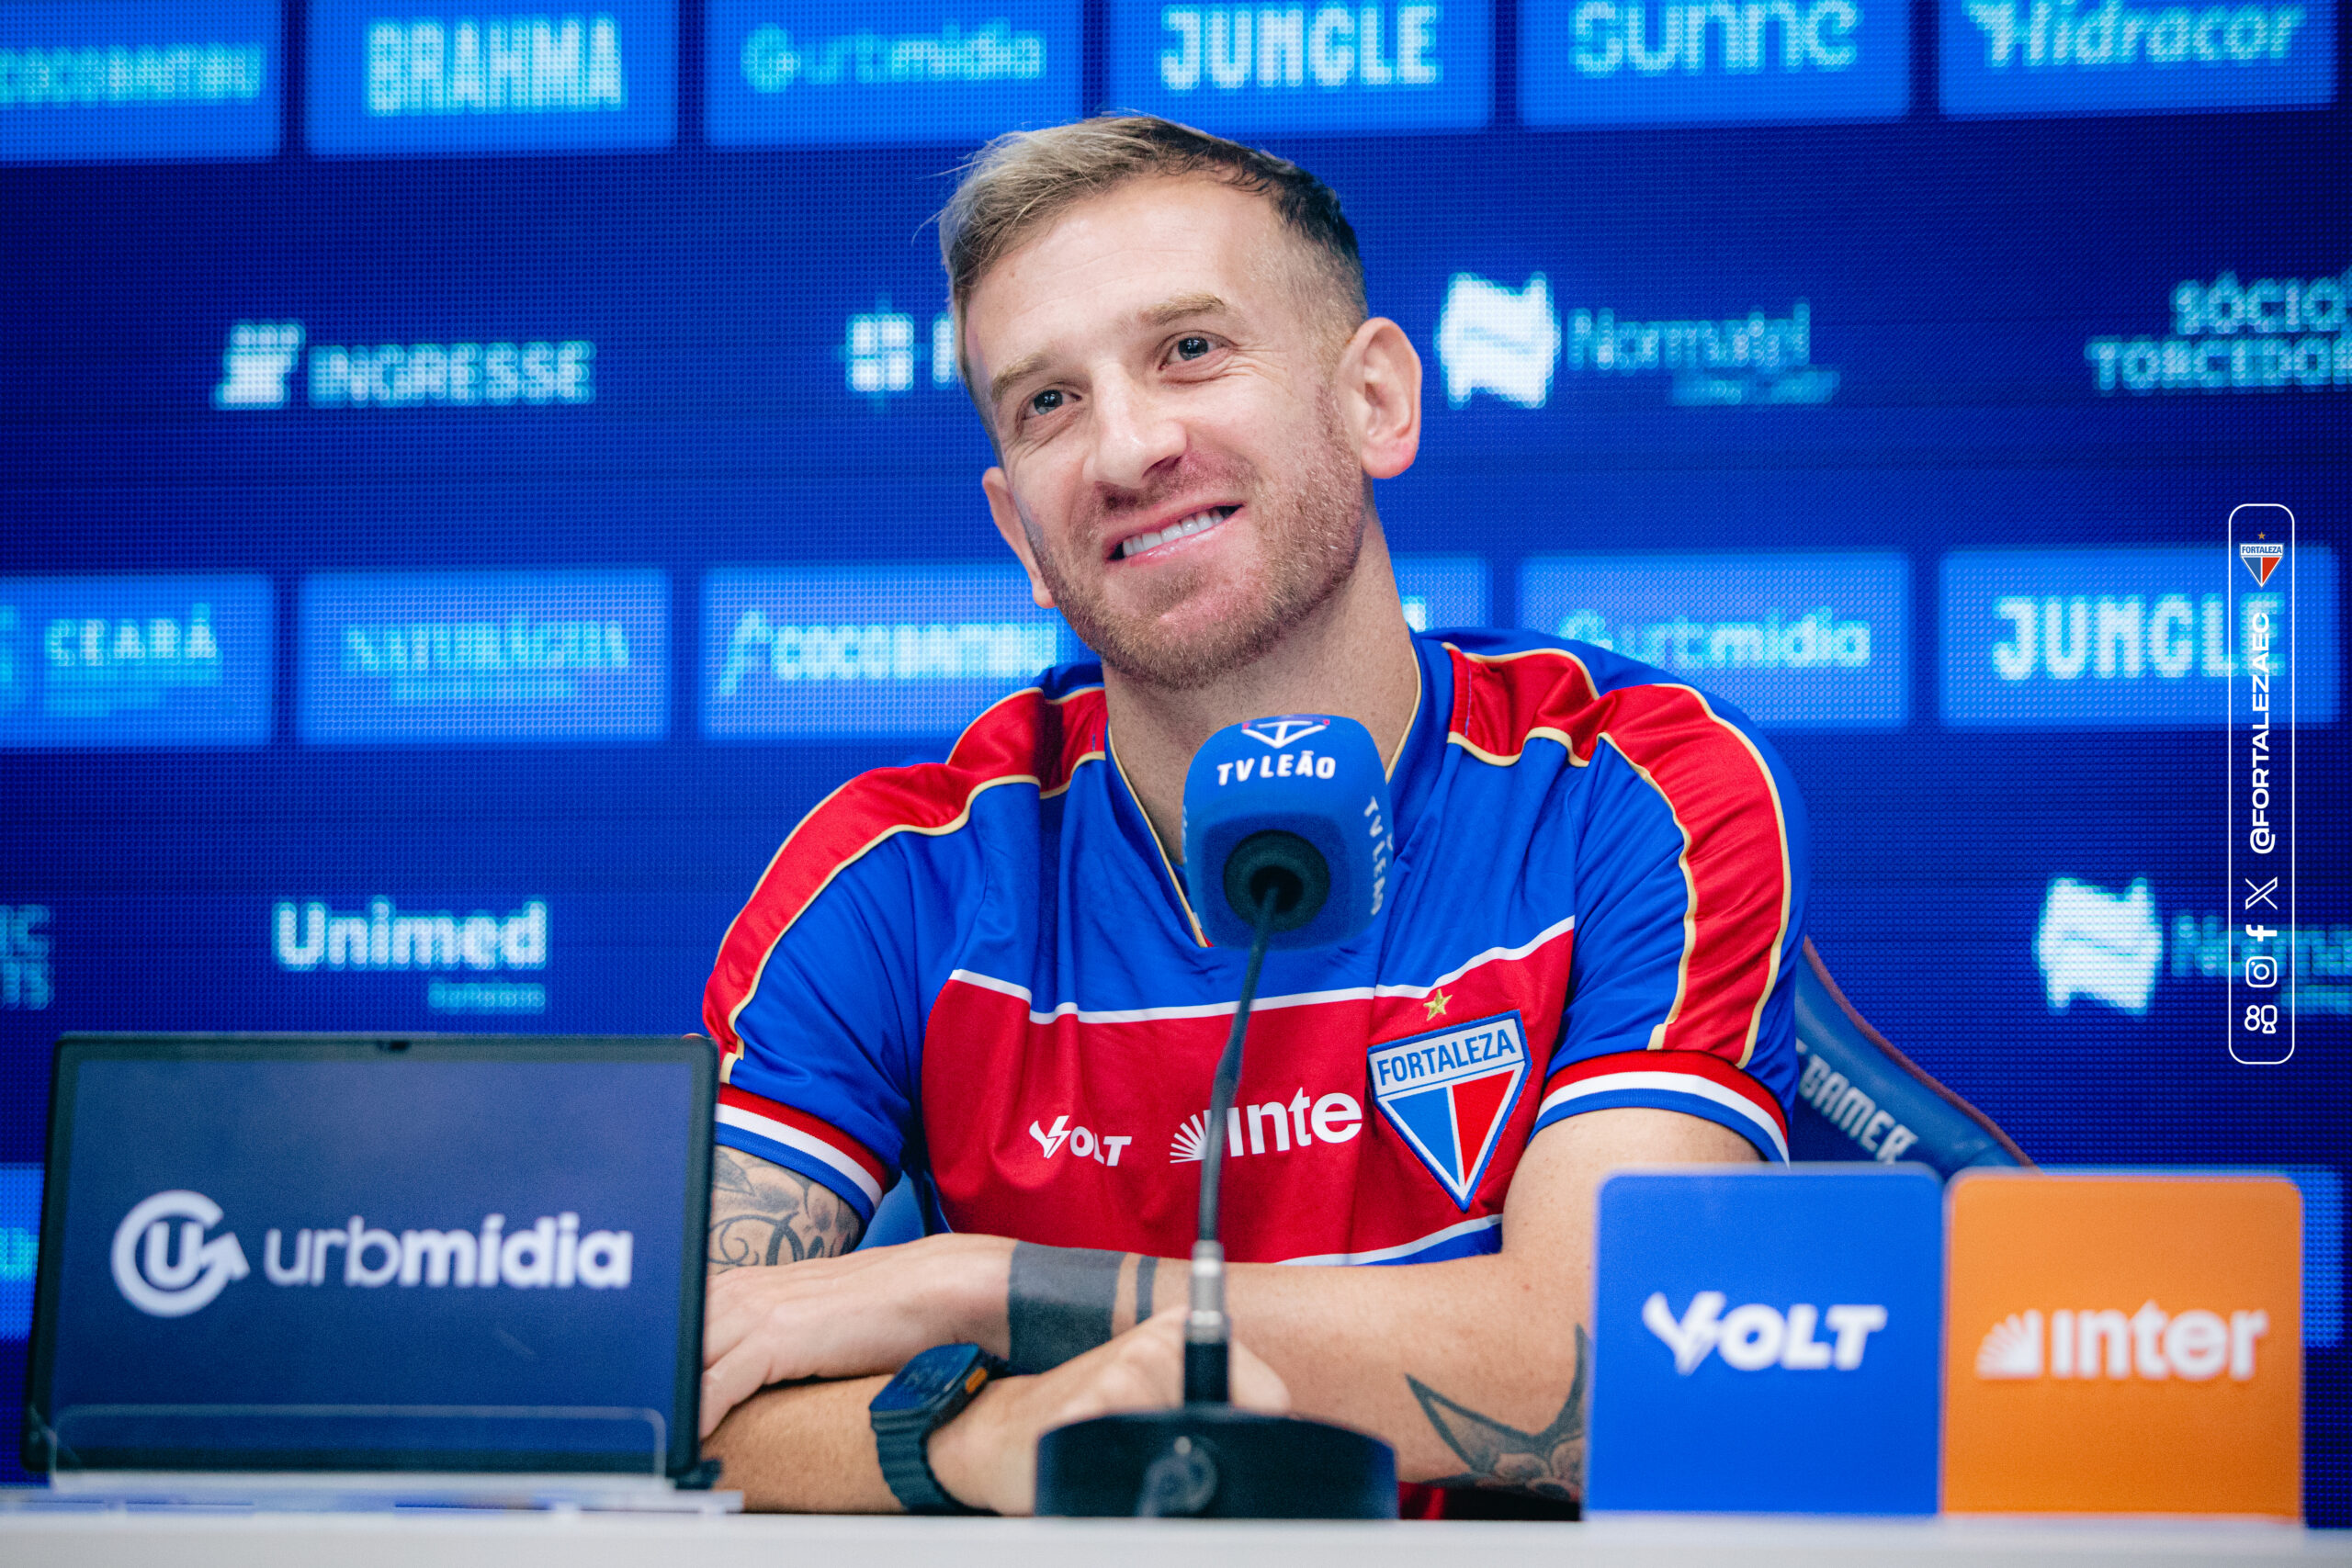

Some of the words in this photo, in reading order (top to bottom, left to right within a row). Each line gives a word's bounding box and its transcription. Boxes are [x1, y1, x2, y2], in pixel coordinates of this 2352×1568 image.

[364, 17, 622, 116] BRAHMA
[1159, 2, 1441, 90] JUNGLE
[309, 342, 595, 408] INGRESSE
[1992, 593, 2288, 682] JUNGLE
[1217, 757, 1255, 786] TV
[1260, 750, 1336, 780] LEÃO
[272, 897, 548, 972] Unimed
[1376, 1028, 1516, 1087] FORTALEZA
[1226, 1086, 1363, 1158] inte
[1798, 1054, 1919, 1165] GAMER
[264, 1212, 634, 1288] urbmídia
[1643, 1289, 1888, 1375] VOLT
